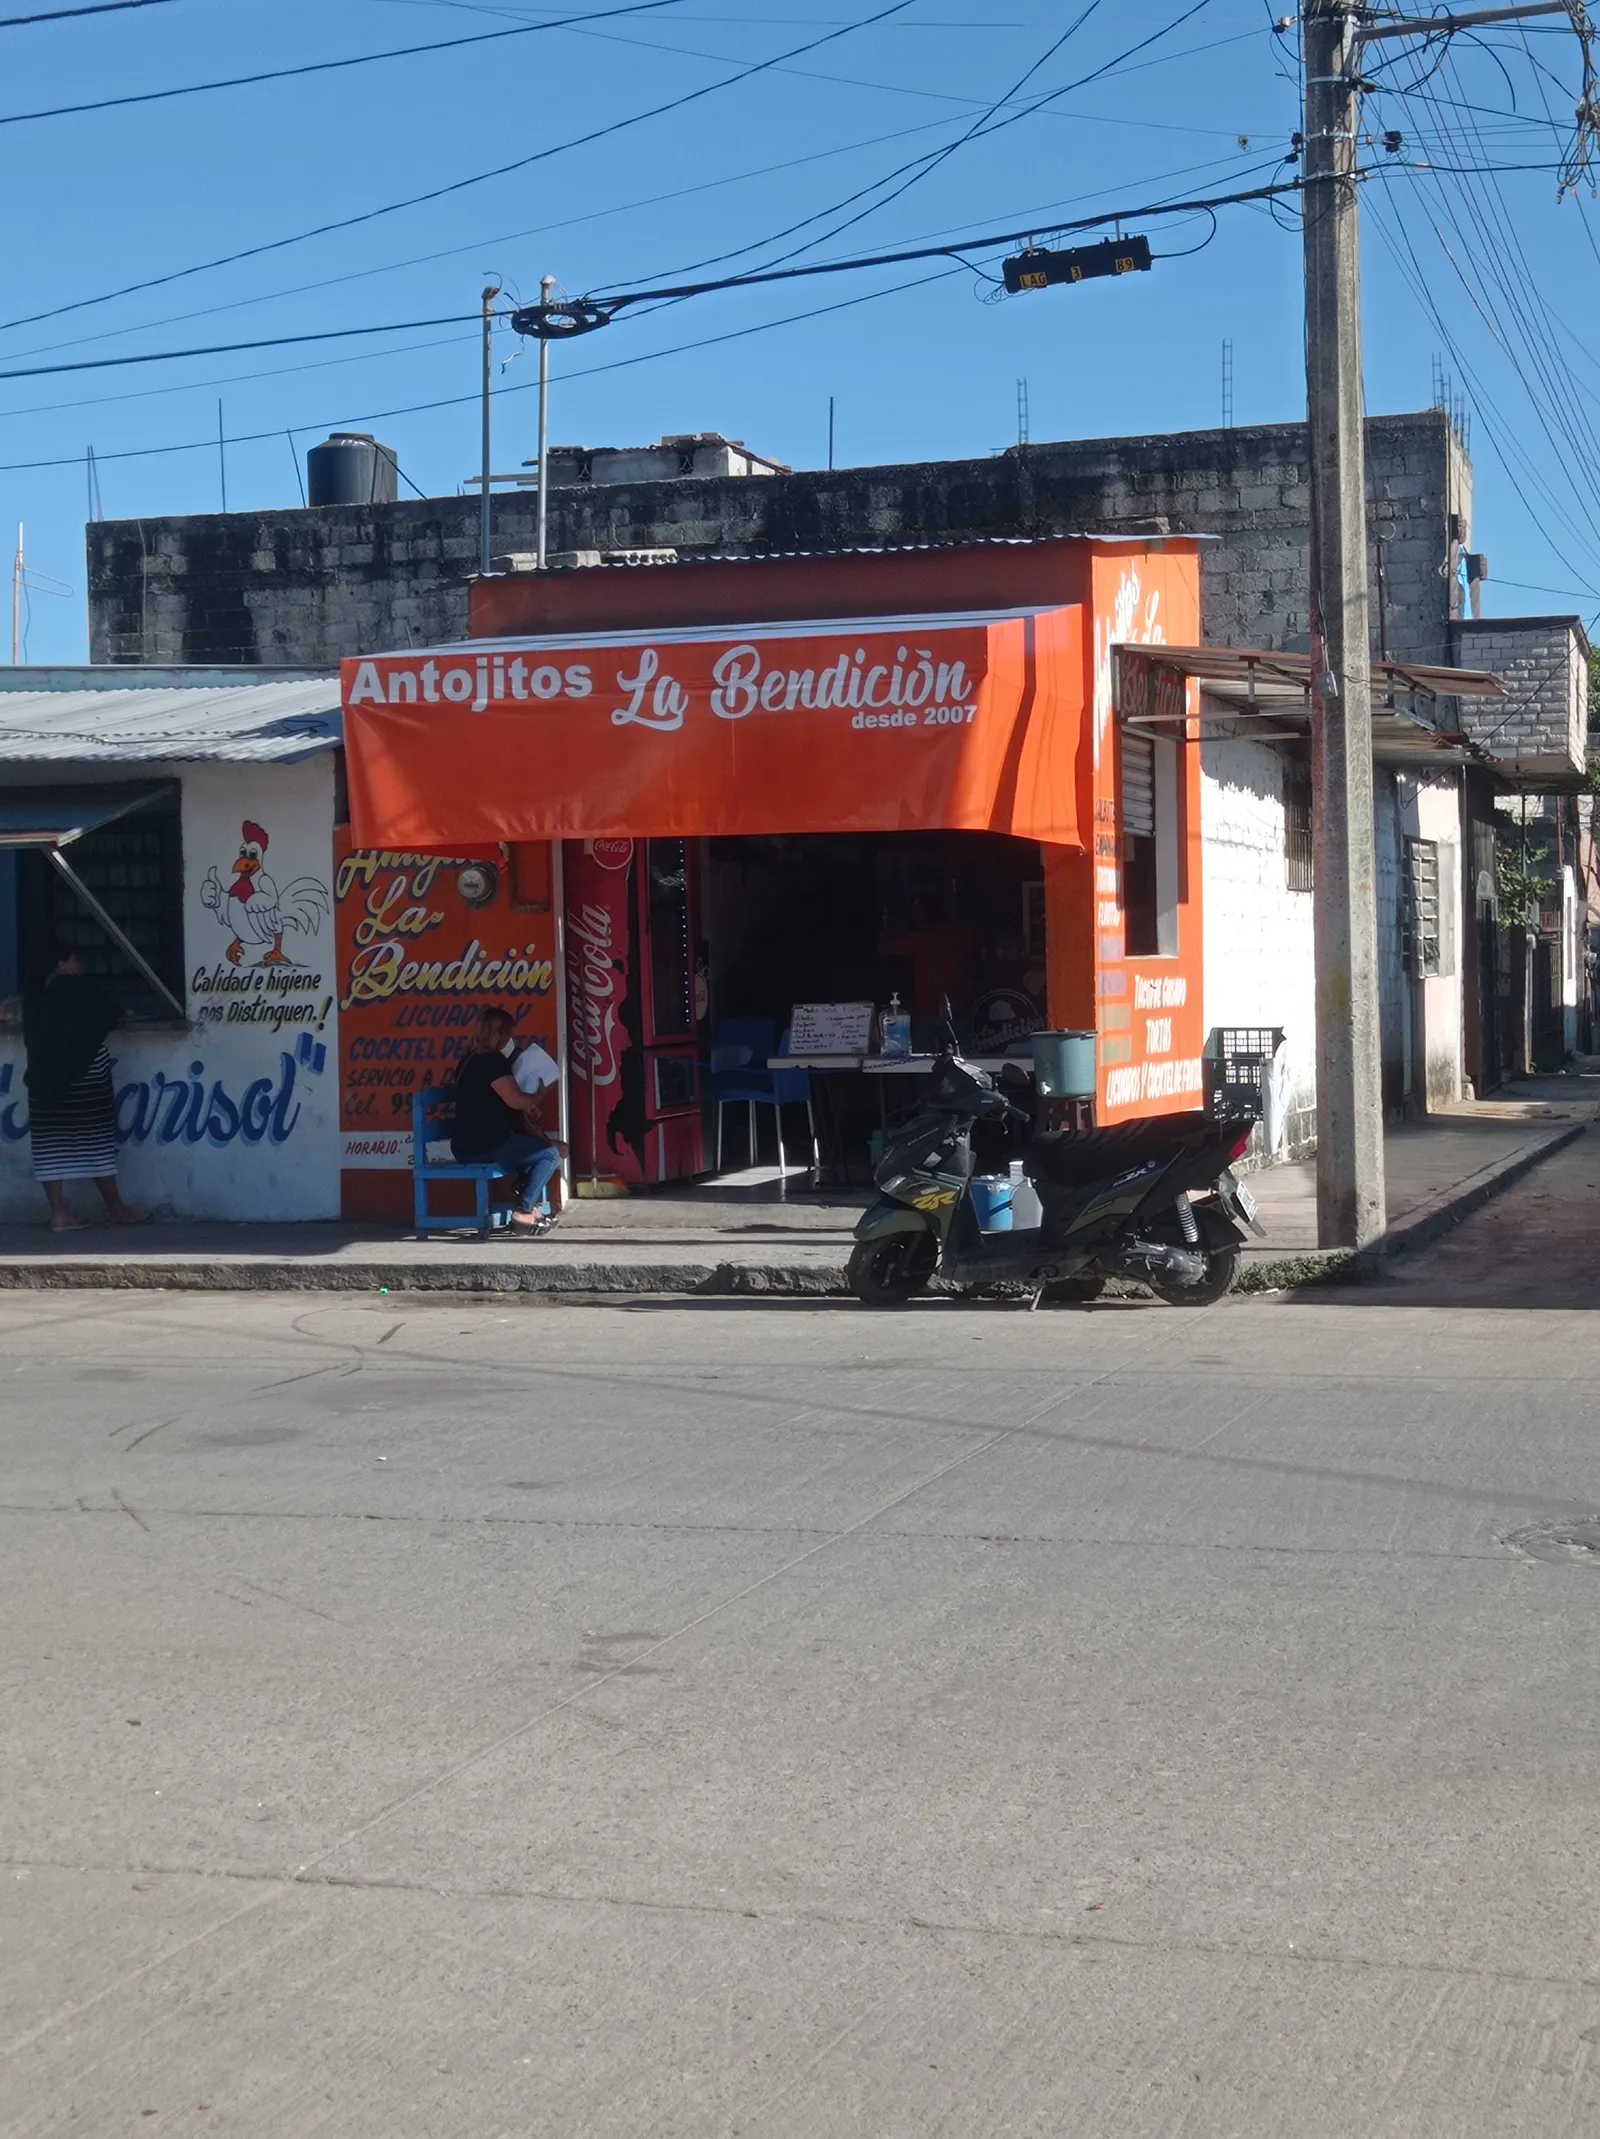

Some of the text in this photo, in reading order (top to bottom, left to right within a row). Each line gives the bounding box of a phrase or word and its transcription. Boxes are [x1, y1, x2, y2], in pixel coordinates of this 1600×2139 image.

[1021, 259, 1134, 287] LAG 3 89
[347, 656, 593, 712] Antojitos
[611, 648, 689, 731] La
[851, 704, 978, 729] desde 2007
[355, 876, 444, 945] La
[191, 965, 322, 998] Calidad e higiene
[341, 937, 554, 1010] Bendición
[567, 903, 617, 1086] Coca-Cola
[200, 1002, 225, 1022] nos
[395, 1003, 506, 1028] LICUAD
[350, 1036, 439, 1062] COCKTEL
[347, 1067, 416, 1088] SERVICIO
[422, 1067, 434, 1087] A
